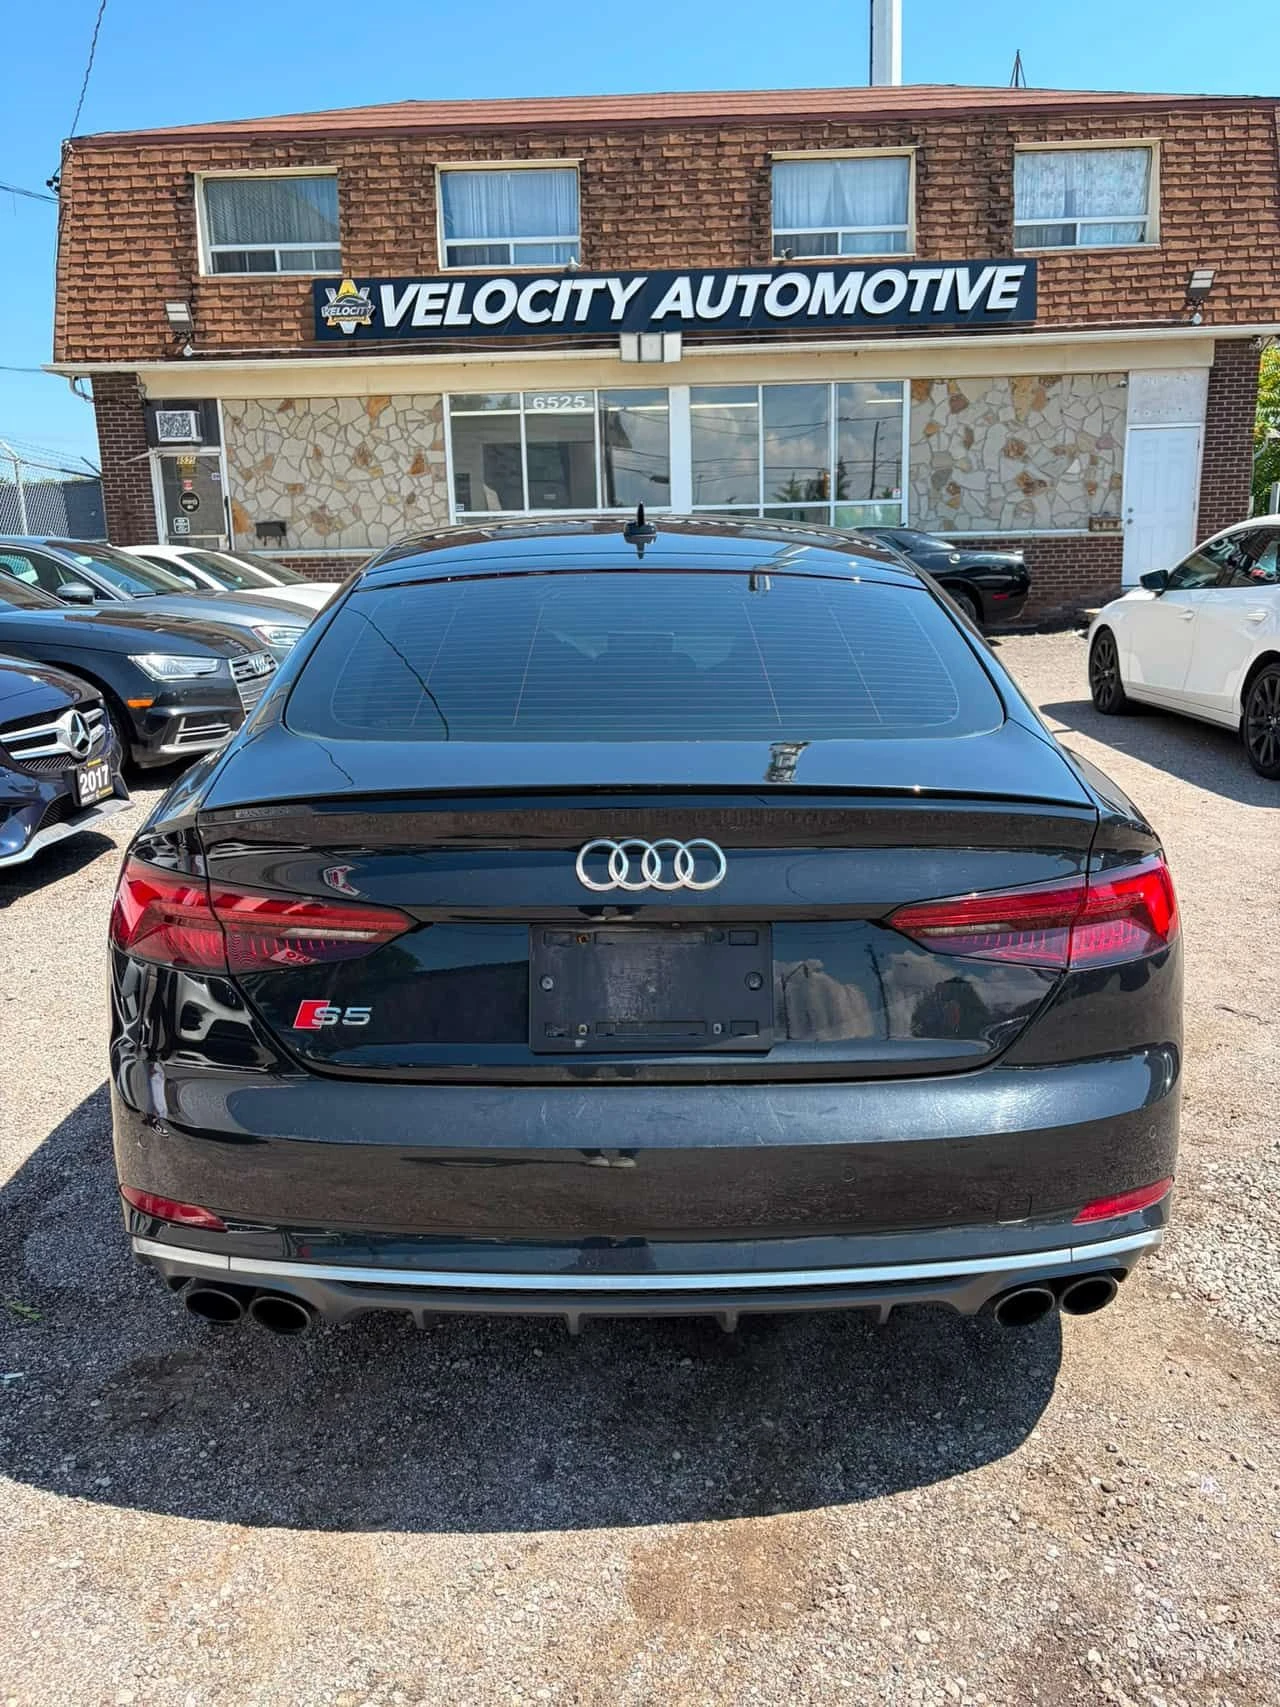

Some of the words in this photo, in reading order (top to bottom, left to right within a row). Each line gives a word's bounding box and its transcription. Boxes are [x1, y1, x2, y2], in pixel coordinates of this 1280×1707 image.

[379, 277, 649, 328] VELOCITY
[650, 264, 1026, 319] AUTOMOTIVE
[320, 304, 376, 318] VELOCITY
[532, 395, 586, 409] 6525
[79, 764, 109, 796] 2017
[311, 1006, 372, 1026] S5
